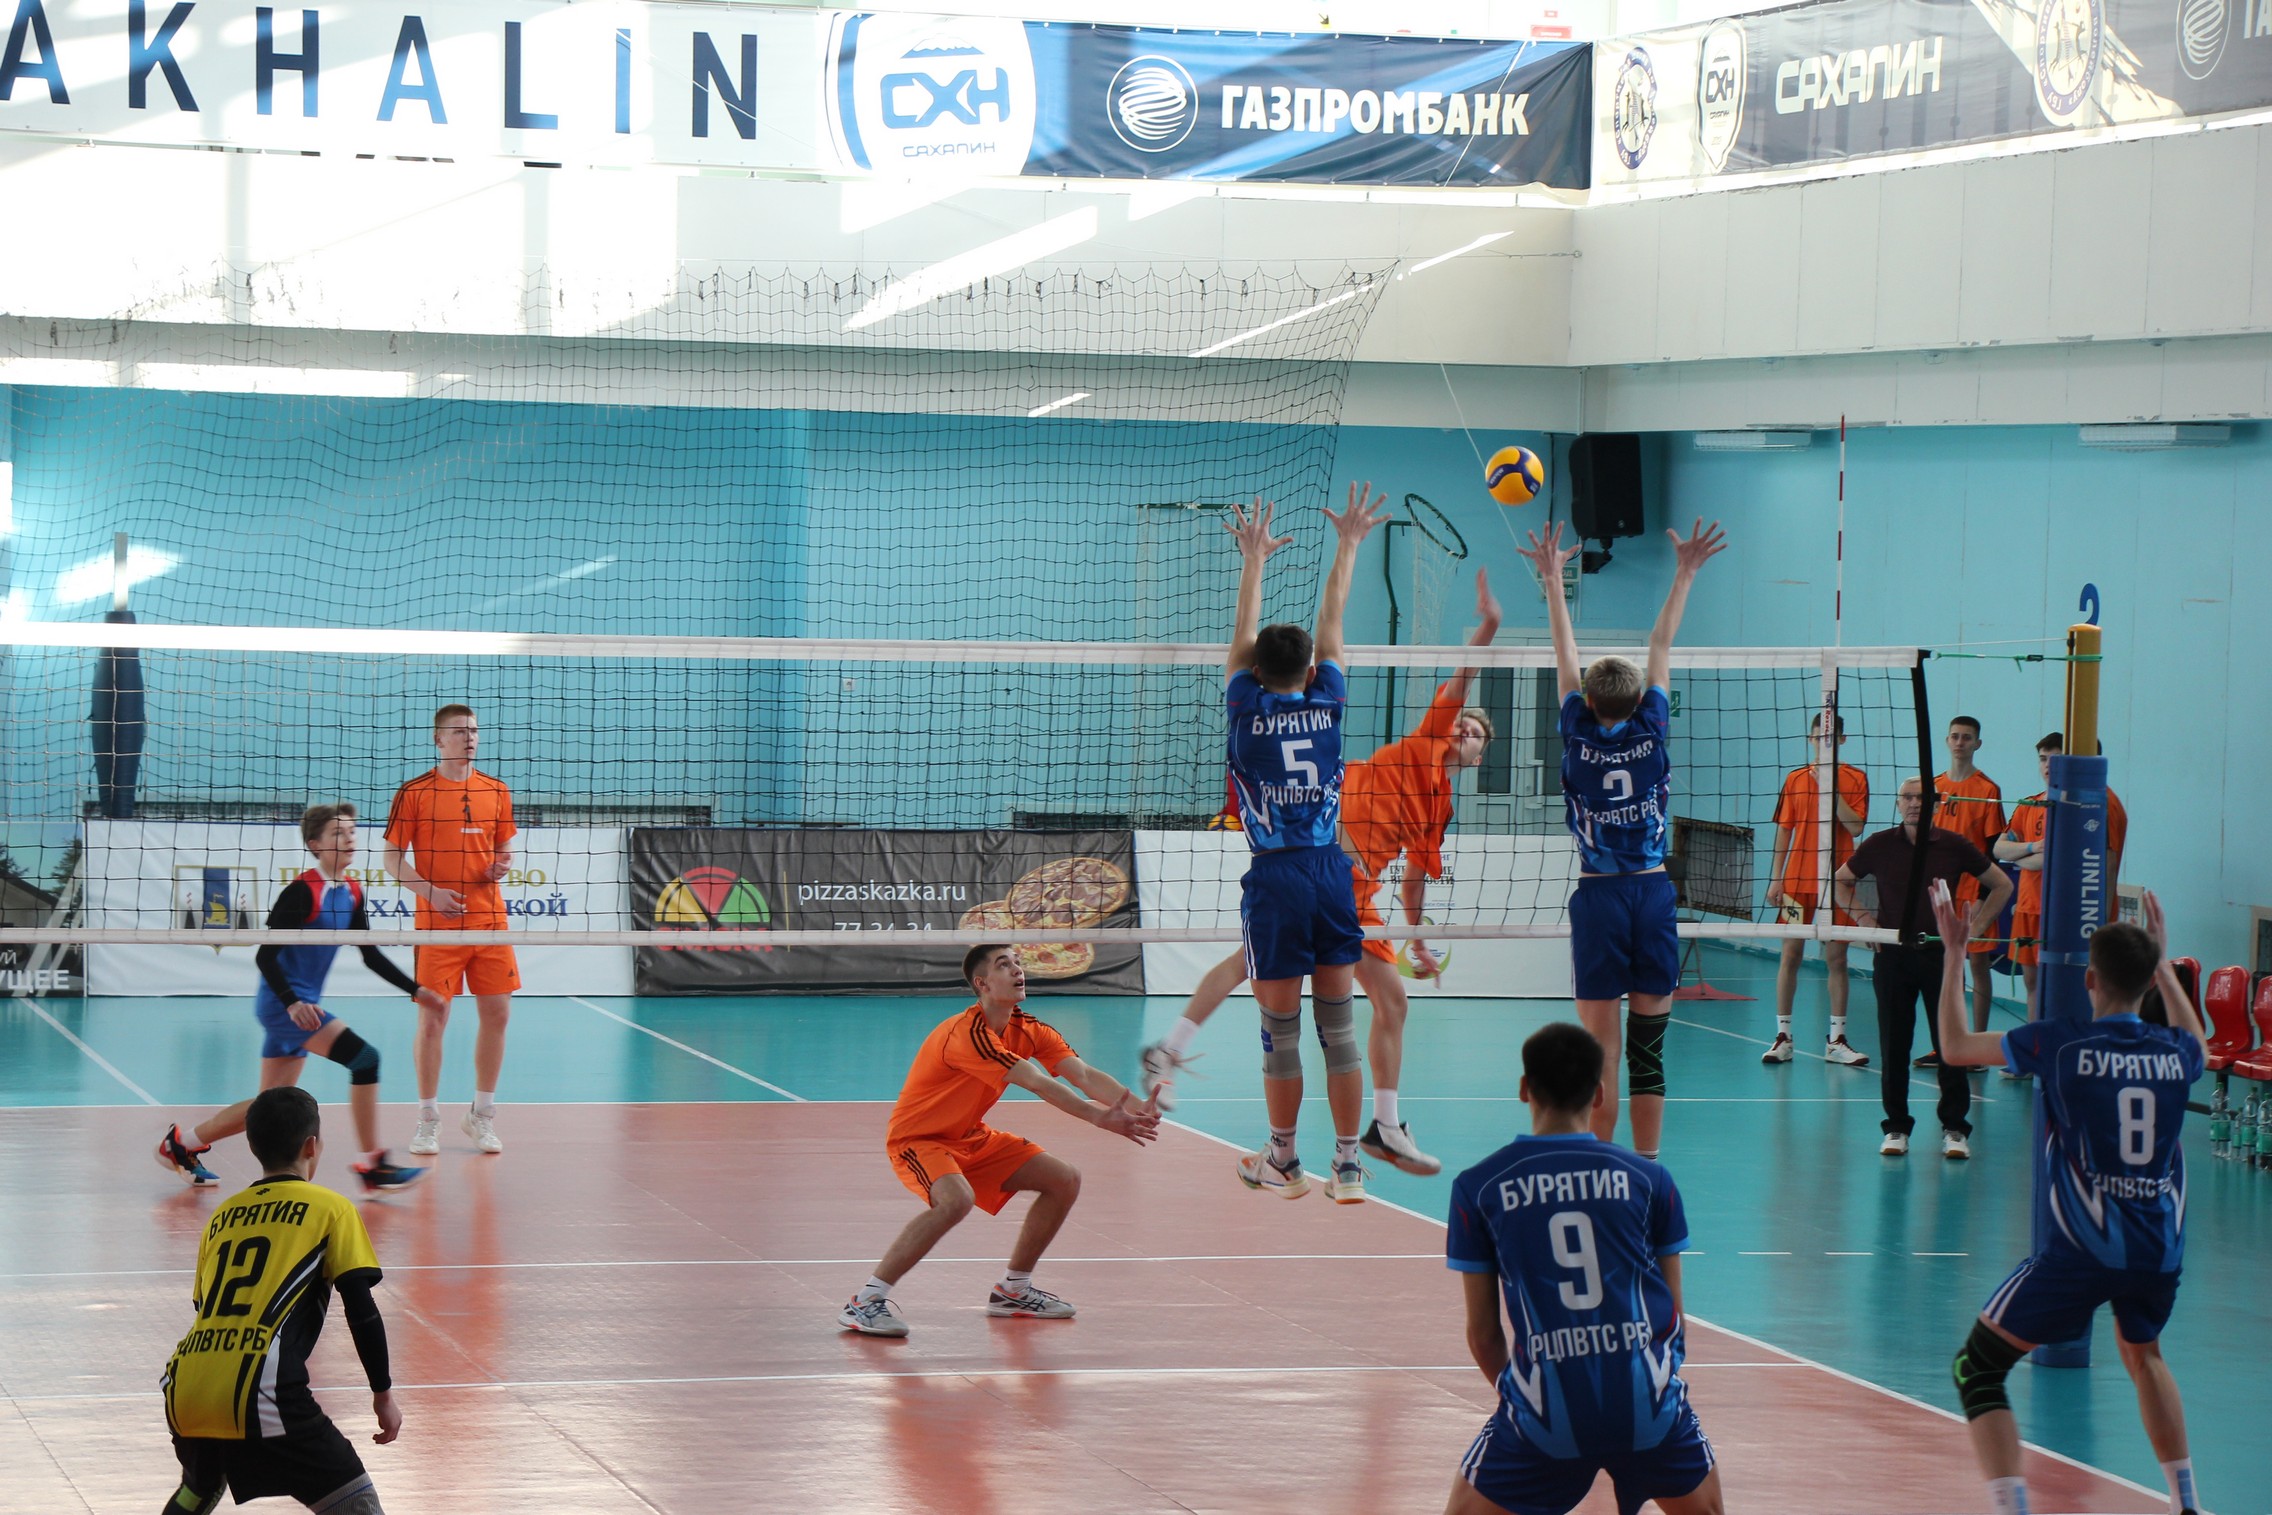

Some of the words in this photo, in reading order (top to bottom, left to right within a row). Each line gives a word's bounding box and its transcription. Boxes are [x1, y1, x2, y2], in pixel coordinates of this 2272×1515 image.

[880, 67, 1011, 129] СХН
[1775, 36, 1943, 115] САХАЛИН
[1221, 85, 1530, 135] ГАЗПРОМБАНК
[902, 141, 996, 158] САХАЛИН
[1252, 708, 1333, 735] БУРЯТИЯ
[1281, 739, 1319, 786] 5
[798, 879, 966, 906] pizzaskazka.ru
[2080, 848, 2100, 939] JINLING
[2077, 1048, 2184, 1081] БУРЯТИЯ
[2117, 1086, 2156, 1166] 8
[1499, 1168, 1630, 1212] БУРЯТИЯ
[209, 1200, 310, 1242] БУРЯТИЯ
[202, 1236, 271, 1319] 12
[1549, 1211, 1604, 1310] 9
[239, 1327, 268, 1351] РБ
[1530, 1323, 1618, 1363] РЦПВТС
[1622, 1321, 1651, 1350] РБ
